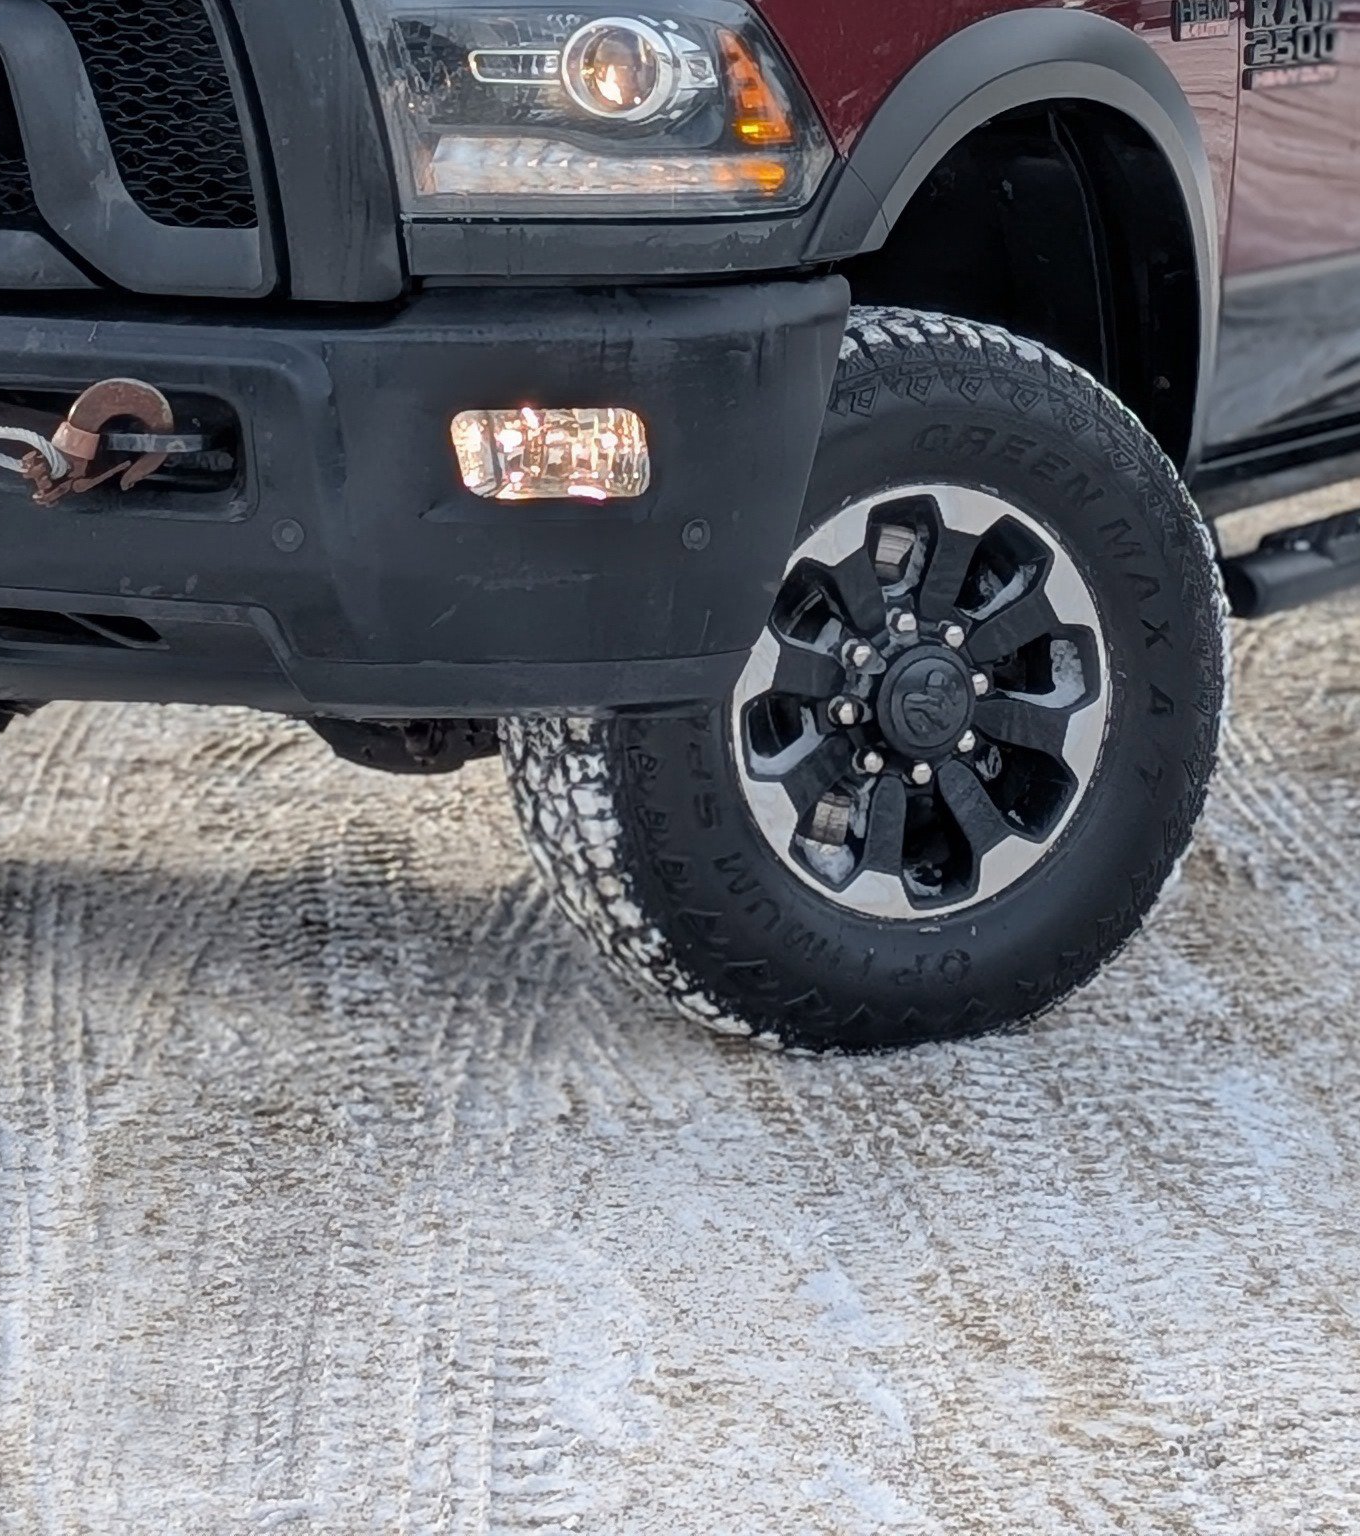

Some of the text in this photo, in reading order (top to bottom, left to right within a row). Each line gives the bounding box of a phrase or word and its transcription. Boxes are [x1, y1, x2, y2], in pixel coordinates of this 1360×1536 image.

[1247, 24, 1339, 65] 2500
[912, 421, 1107, 510] GREEN
[1099, 514, 1175, 653] MAX
